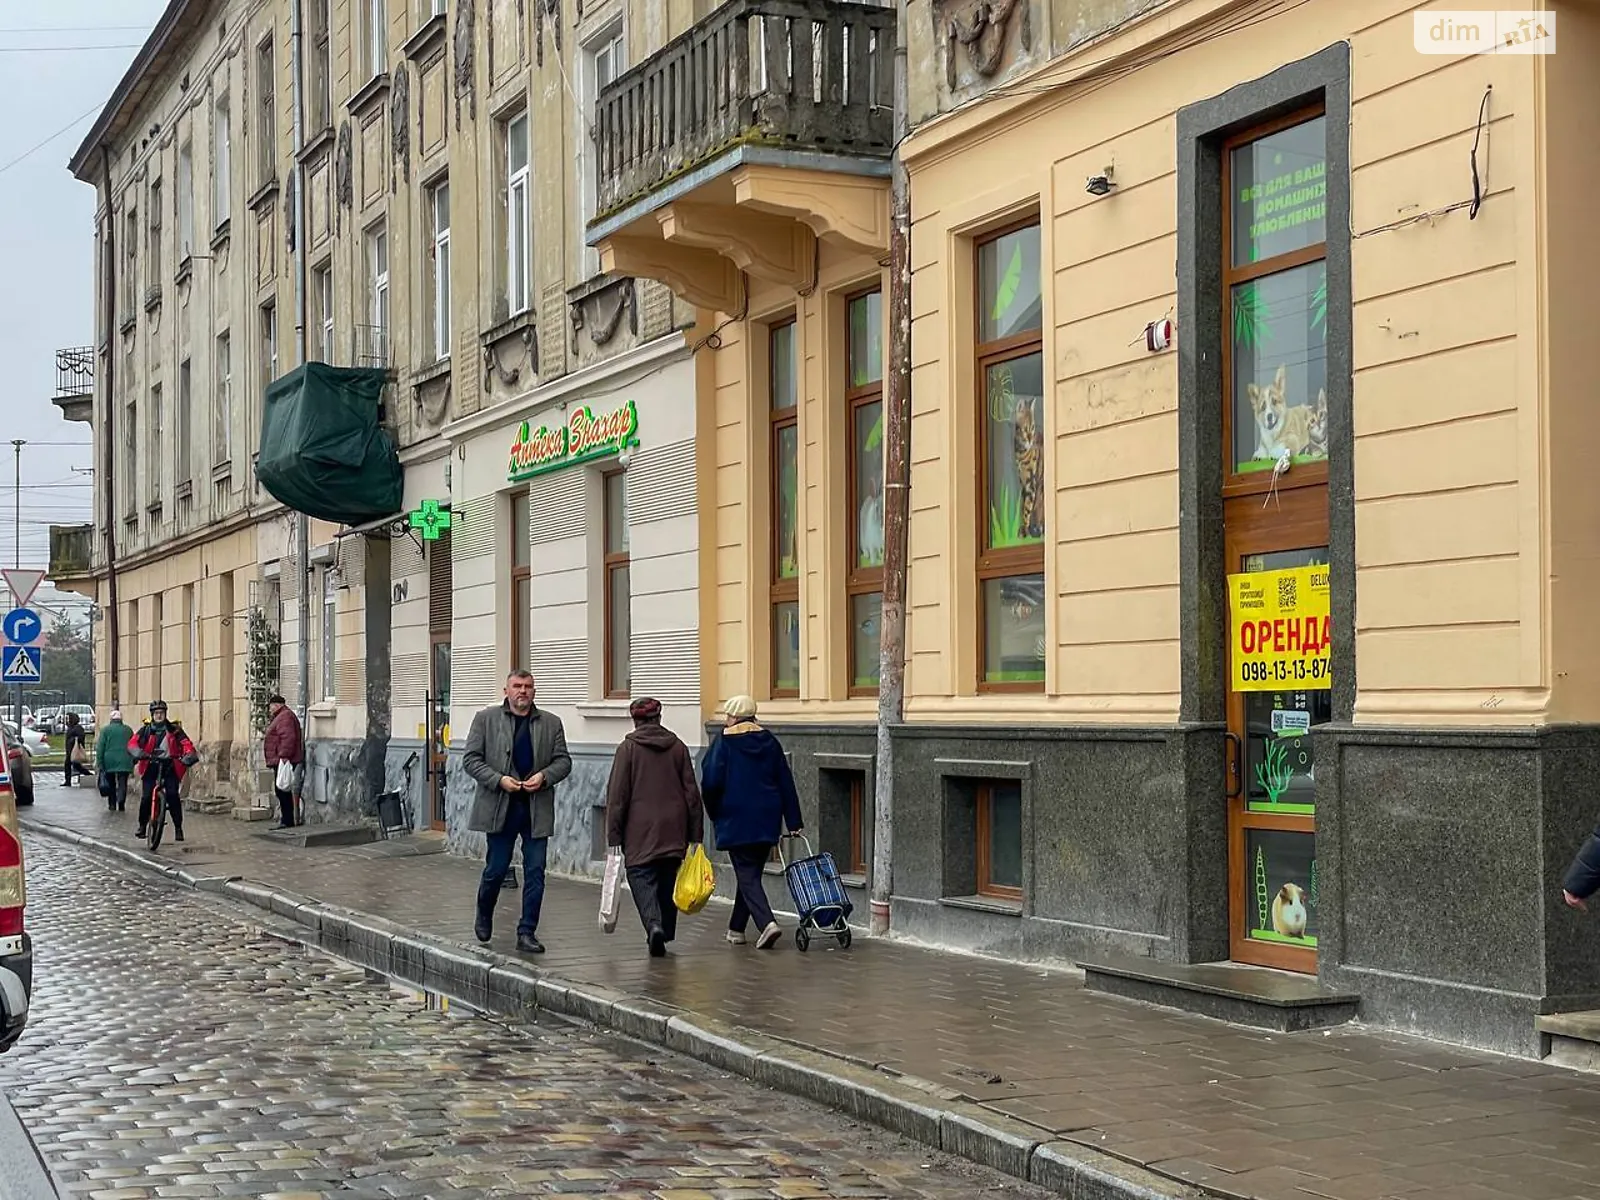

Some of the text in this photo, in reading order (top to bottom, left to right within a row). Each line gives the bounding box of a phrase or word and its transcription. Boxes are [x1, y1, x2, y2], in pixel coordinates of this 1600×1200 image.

[1265, 174, 1292, 196] ДЛЯ
[508, 401, 636, 471] Аптека Знахар
[1241, 615, 1331, 655] ОРЕНДА
